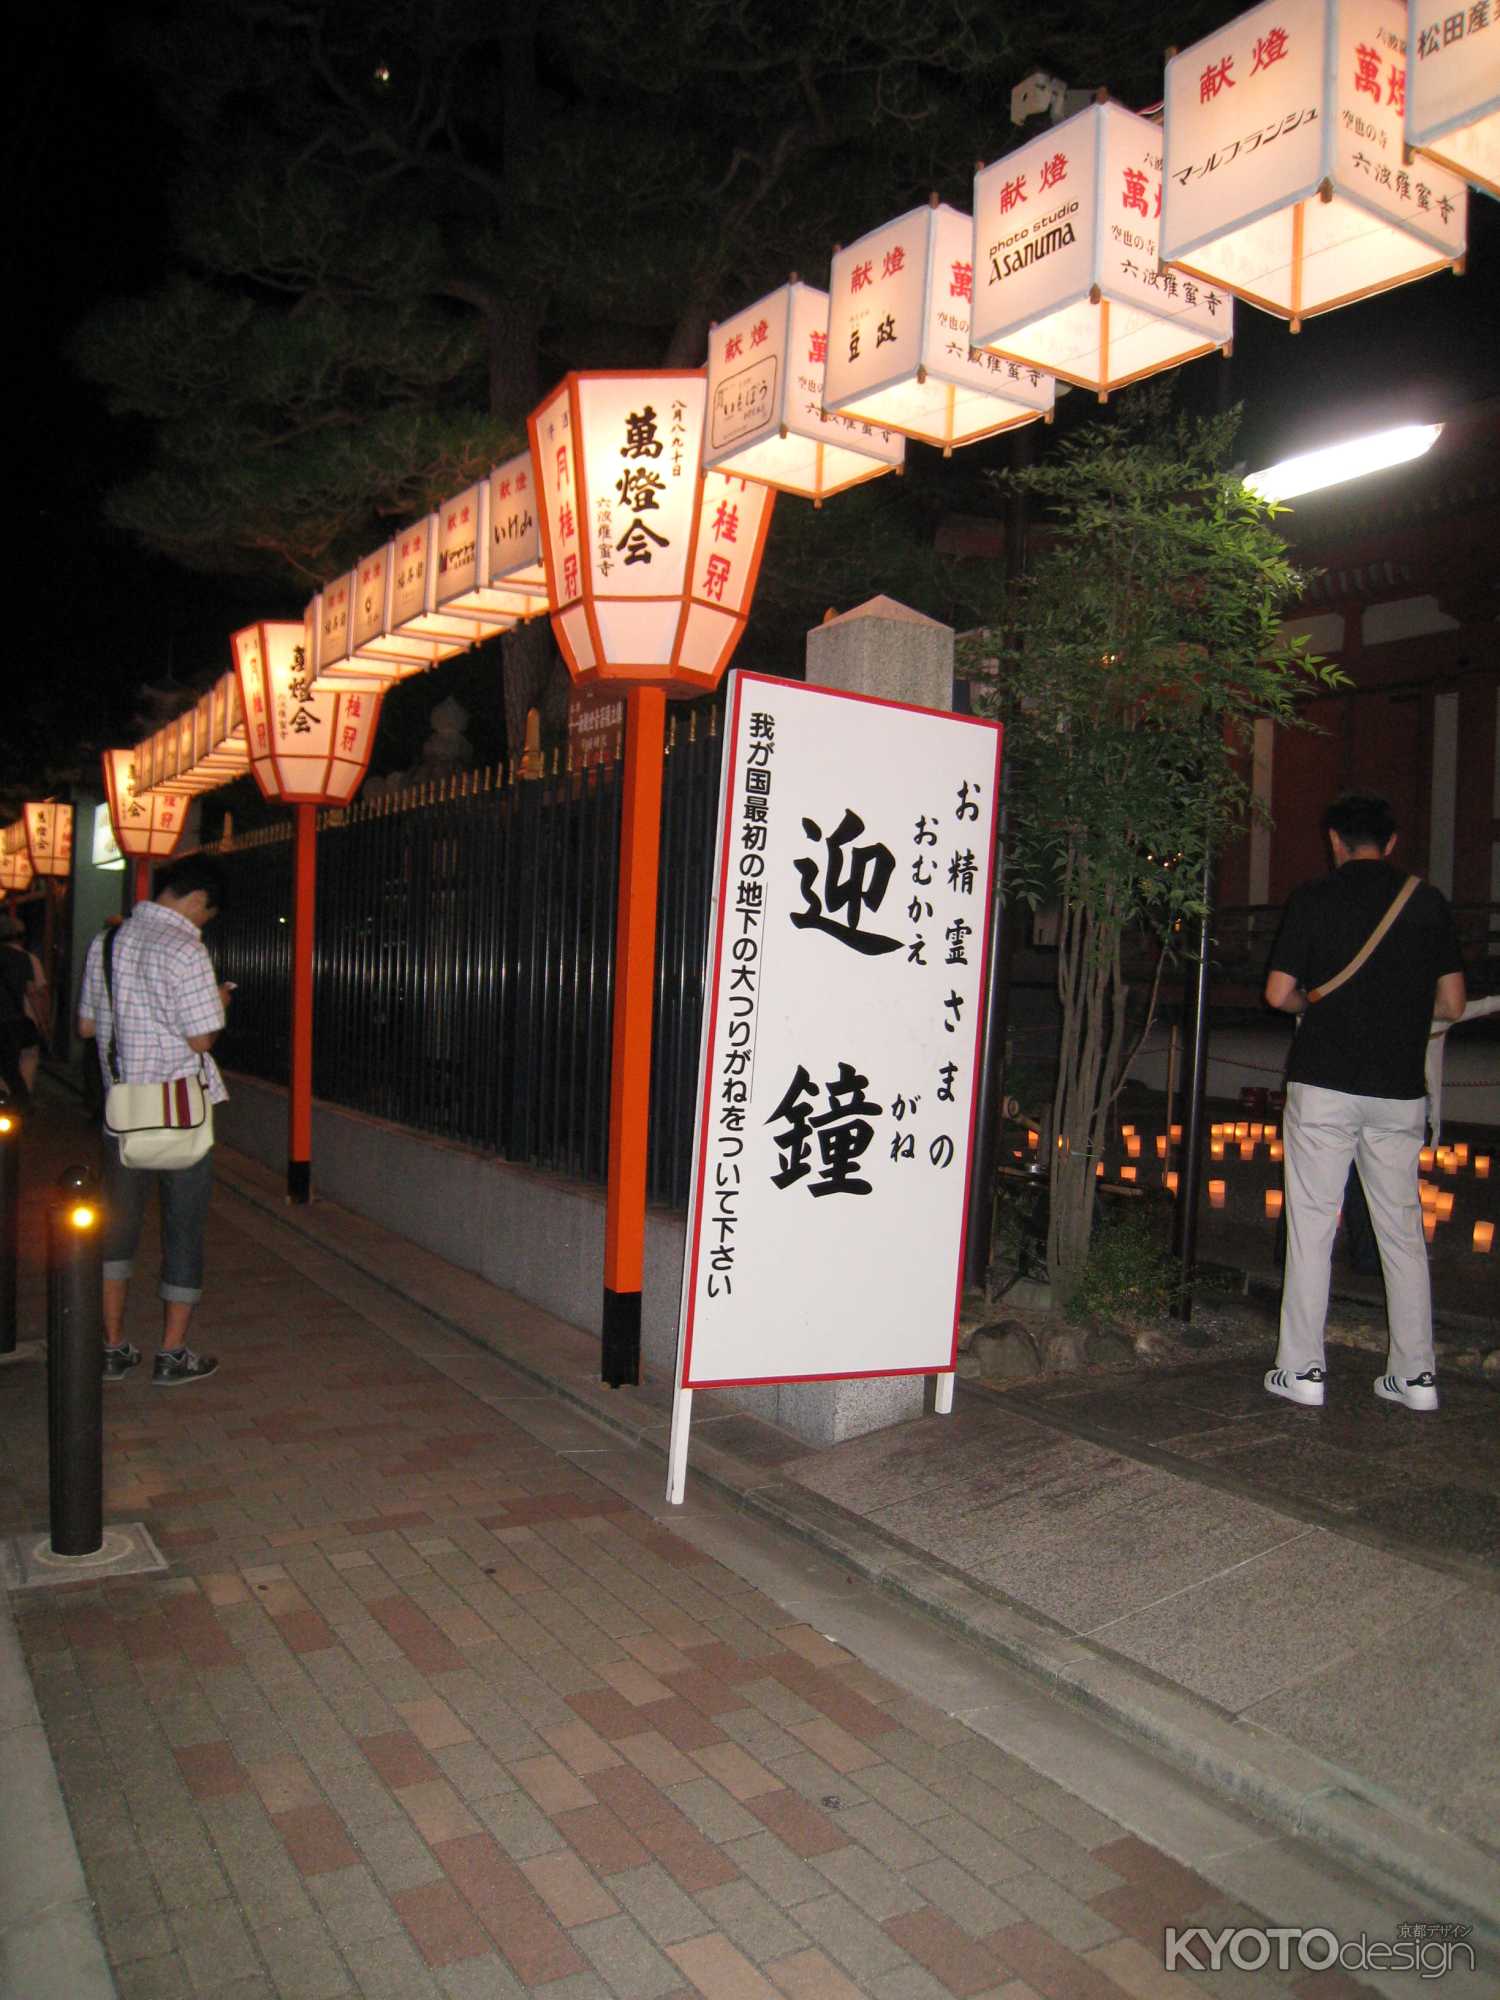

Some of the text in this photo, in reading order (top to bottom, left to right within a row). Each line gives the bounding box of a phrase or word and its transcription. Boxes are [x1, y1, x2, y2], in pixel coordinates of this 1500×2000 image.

[1200, 25, 1290, 104] 献燈
[1417, 0, 1500, 61] 松田産
[1000, 152, 1068, 215] 献燈
[1352, 152, 1455, 225] 六波羅蜜寺
[988, 222, 1076, 287] Asanuma
[989, 201, 1080, 258] photo studio
[851, 245, 905, 294] 献燈
[615, 405, 670, 566] 萬燈会
[702, 475, 746, 602] 桂冠
[707, 712, 775, 1297] 我が国最初の地下の大つりがねをついて下さい
[890, 815, 938, 1160] おむかえ がね
[929, 781, 981, 1169] お精霊さまの
